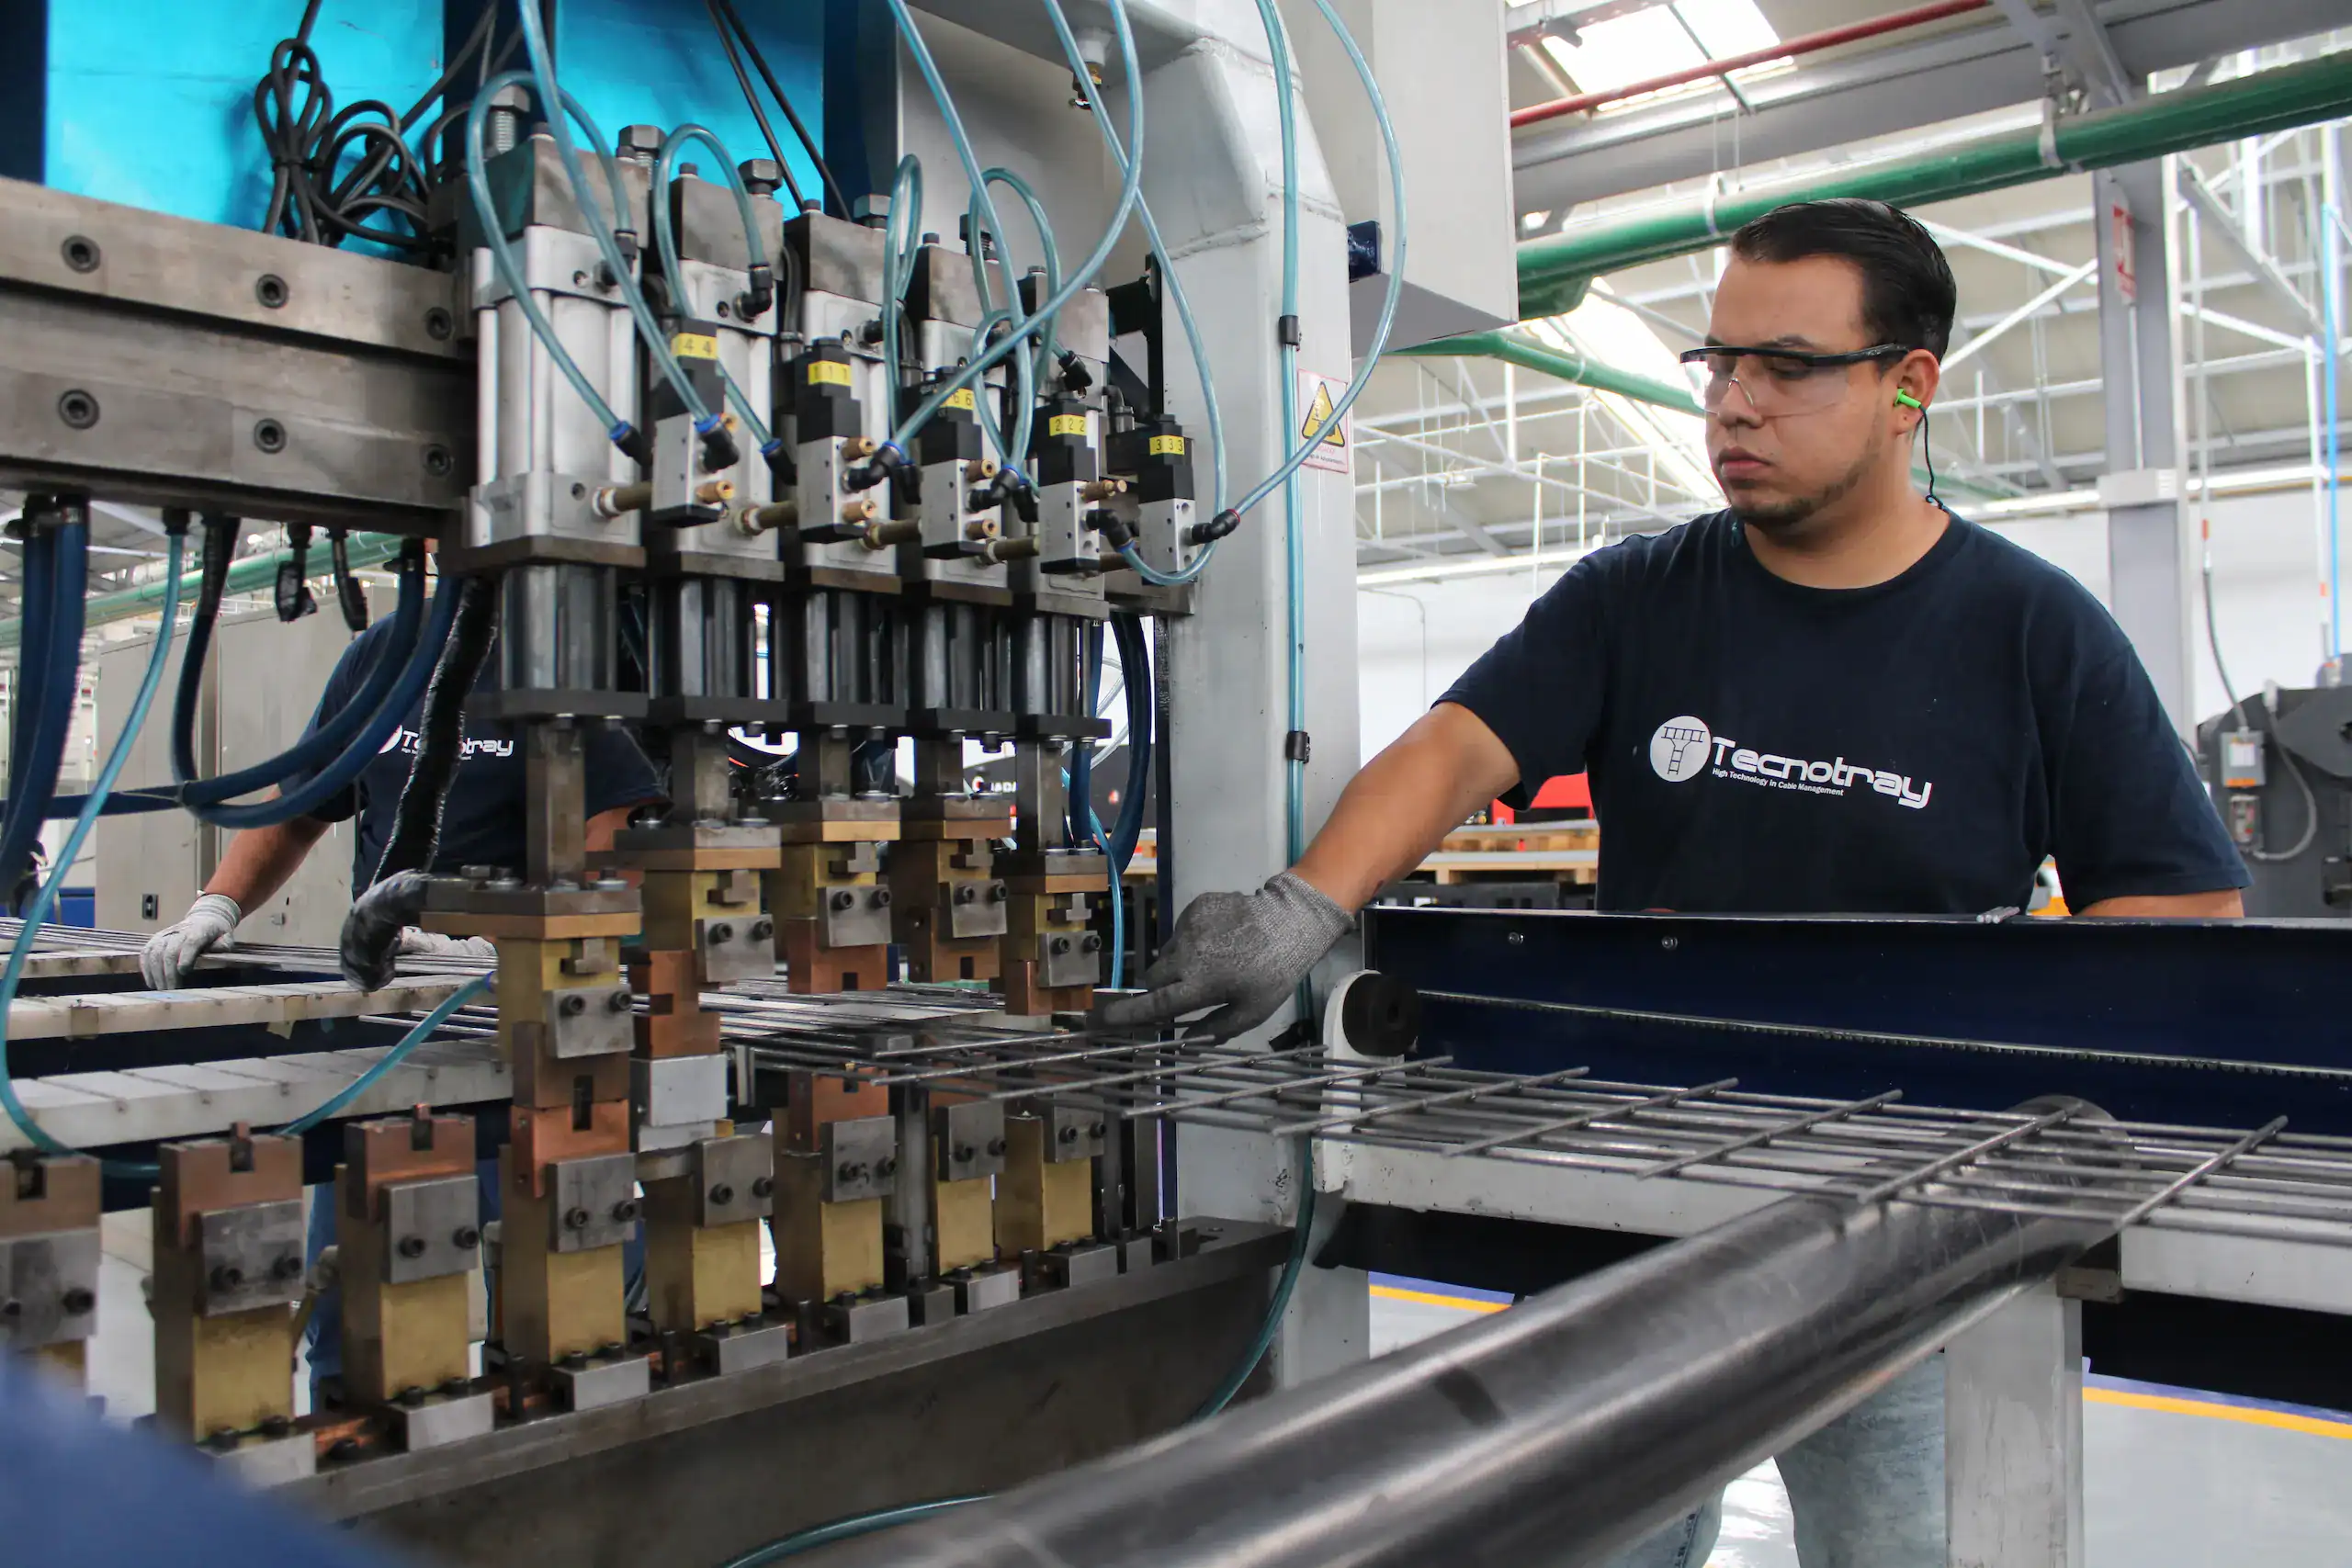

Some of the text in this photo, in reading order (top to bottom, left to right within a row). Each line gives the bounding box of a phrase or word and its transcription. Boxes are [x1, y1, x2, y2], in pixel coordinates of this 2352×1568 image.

[1055, 418, 1085, 433] 222
[1155, 437, 1184, 452] 333
[1712, 736, 1933, 809] Tecnotray
[1712, 767, 1729, 779] High
[1729, 770, 1769, 787] Technology
[1778, 780, 1798, 791] Cable
[1797, 783, 1844, 796] Management
